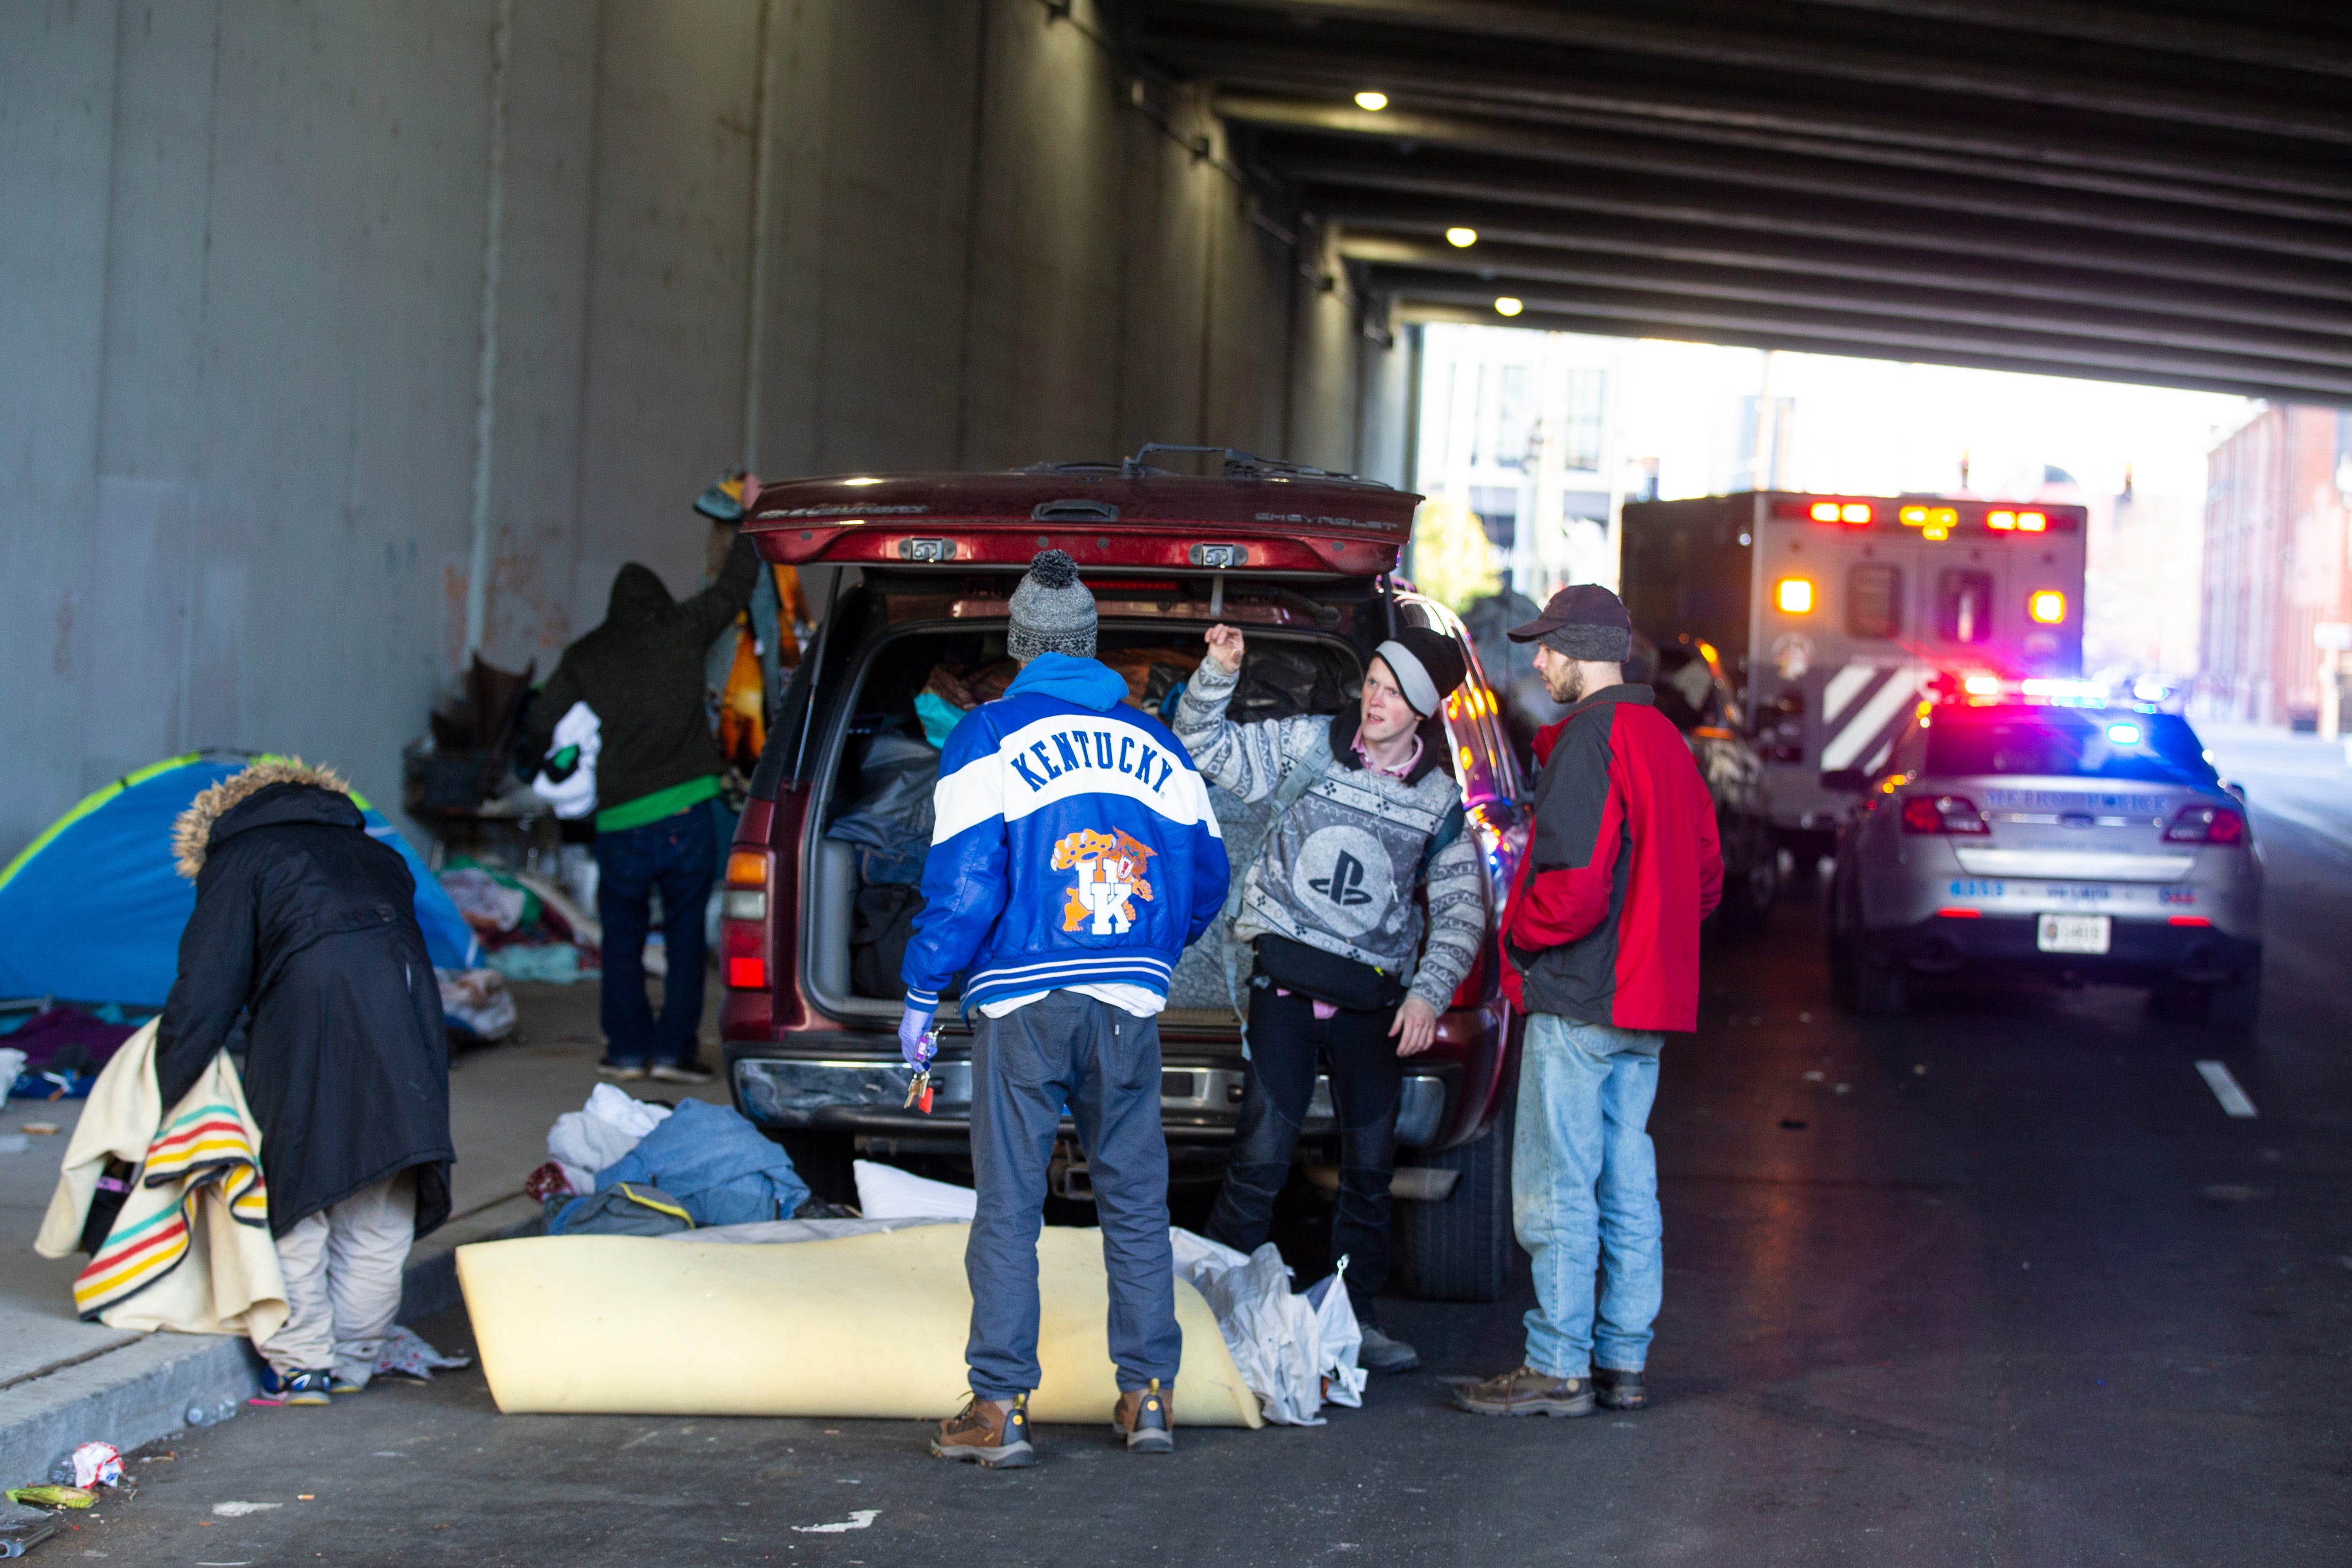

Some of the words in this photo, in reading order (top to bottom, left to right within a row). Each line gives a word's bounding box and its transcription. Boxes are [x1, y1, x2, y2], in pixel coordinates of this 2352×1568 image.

[1255, 512, 1398, 530] CHEVROLET
[1010, 730, 1172, 793] KENTUCKY
[1075, 858, 1132, 935] UK
